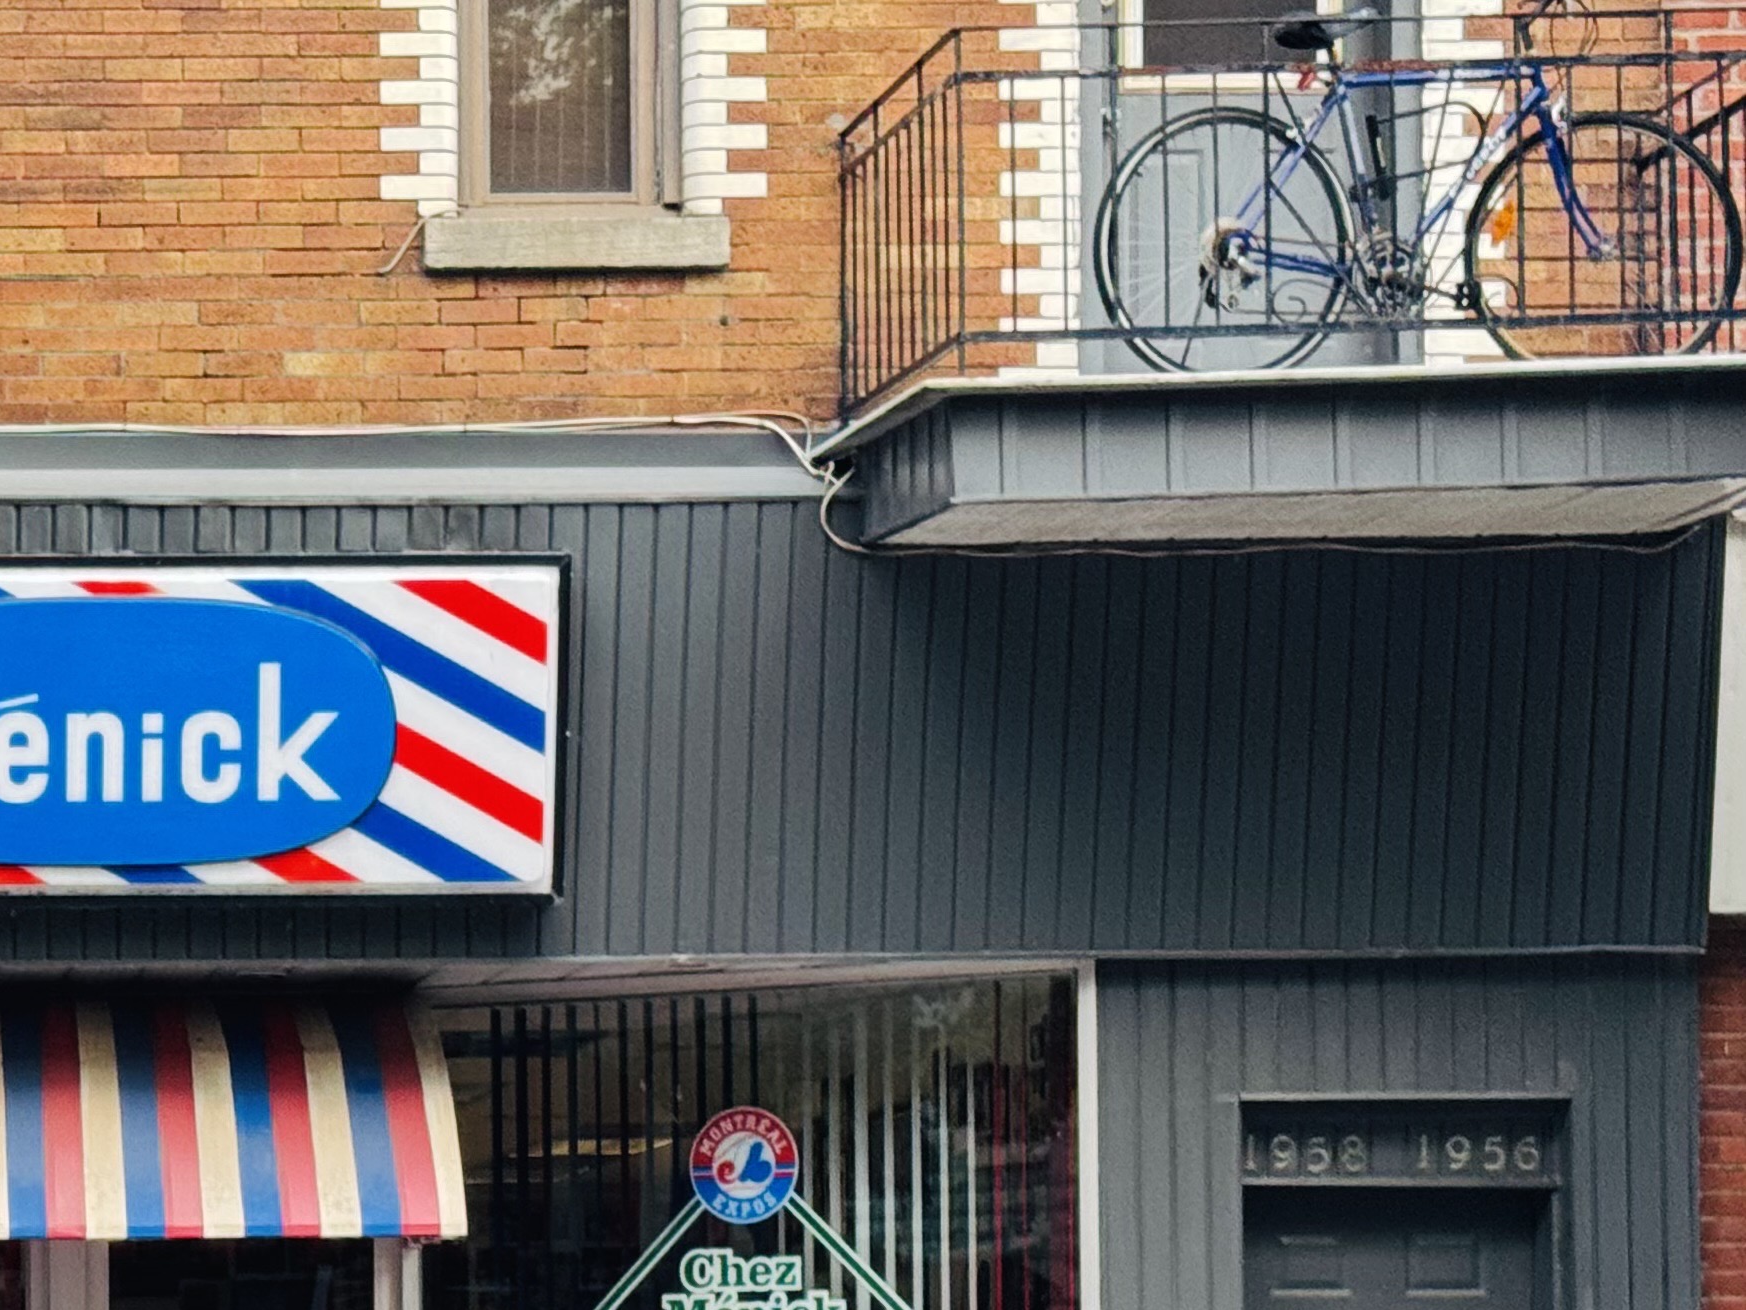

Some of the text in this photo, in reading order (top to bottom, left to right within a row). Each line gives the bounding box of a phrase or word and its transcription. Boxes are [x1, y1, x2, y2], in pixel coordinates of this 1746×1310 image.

[1416, 1133, 1541, 1172] 1956
[711, 1190, 777, 1218] EXPOS
[681, 1249, 803, 1294] Chez
